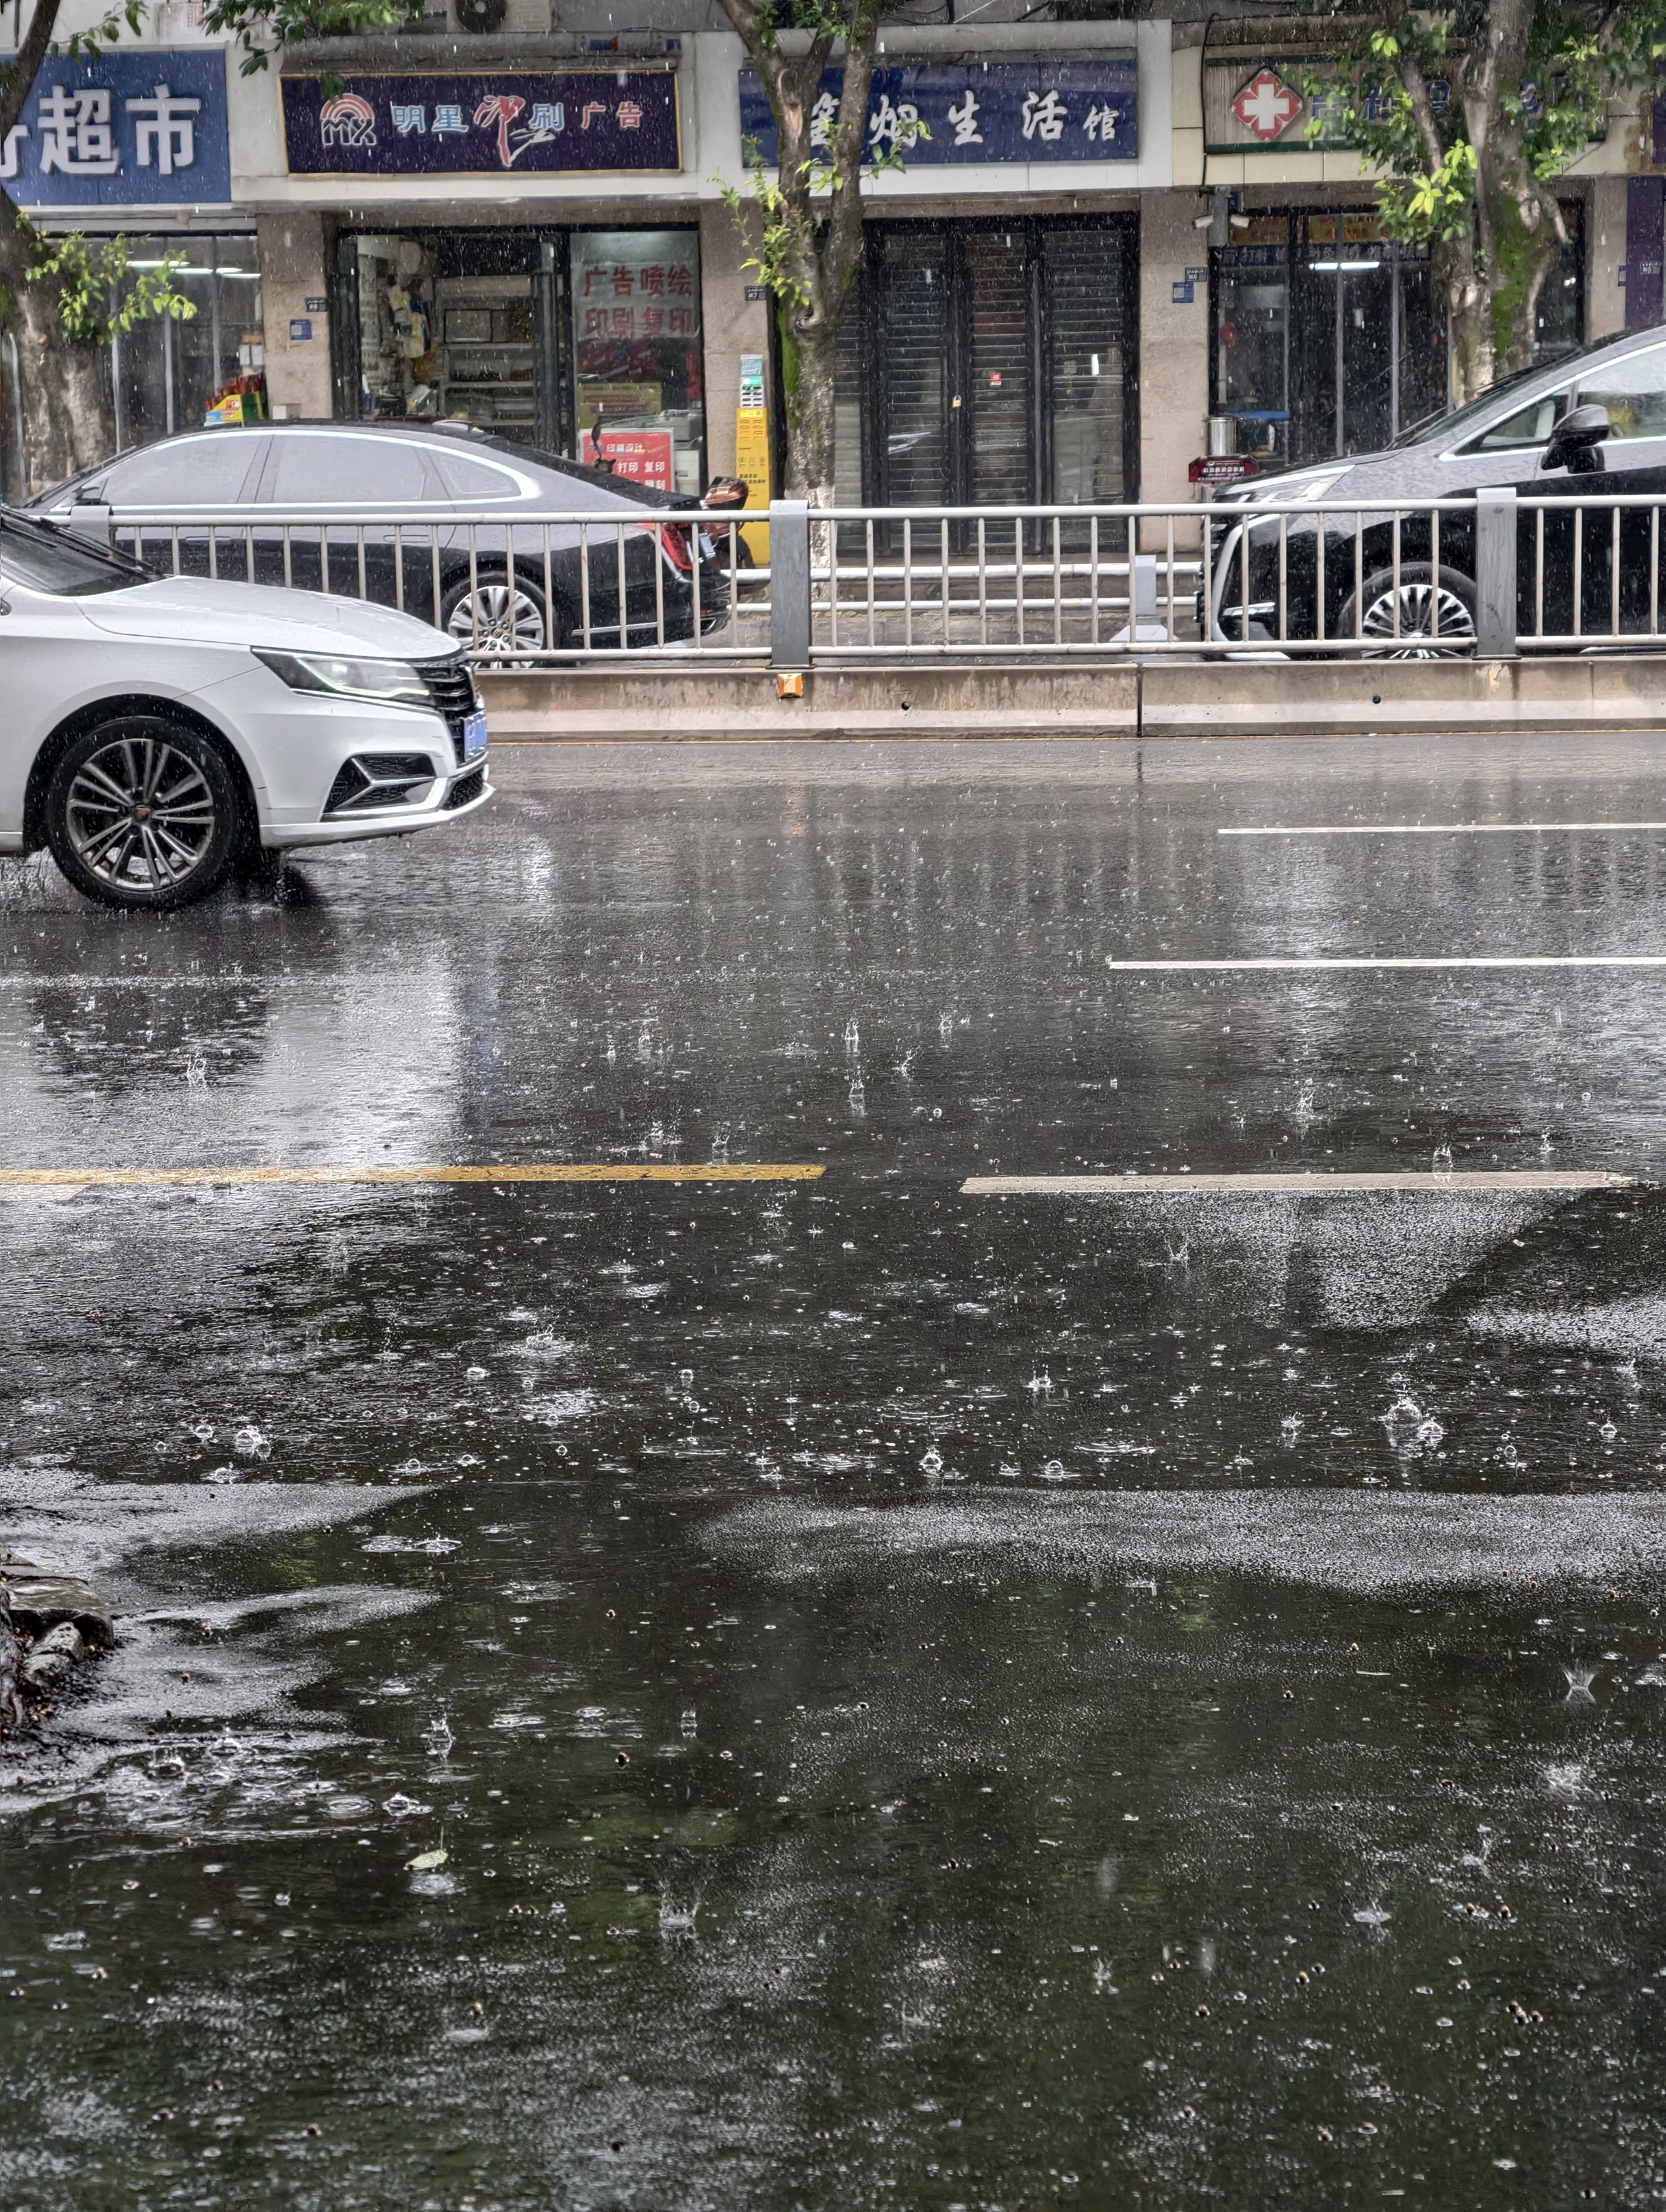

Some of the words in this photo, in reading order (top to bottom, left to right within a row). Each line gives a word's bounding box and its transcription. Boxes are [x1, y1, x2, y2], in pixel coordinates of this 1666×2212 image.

[0, 83, 201, 178] 超市
[583, 264, 694, 297] 广告喷绘
[585, 305, 693, 340] 印刷复印
[617, 461, 638, 473] 打印
[644, 461, 665, 473] 复印
